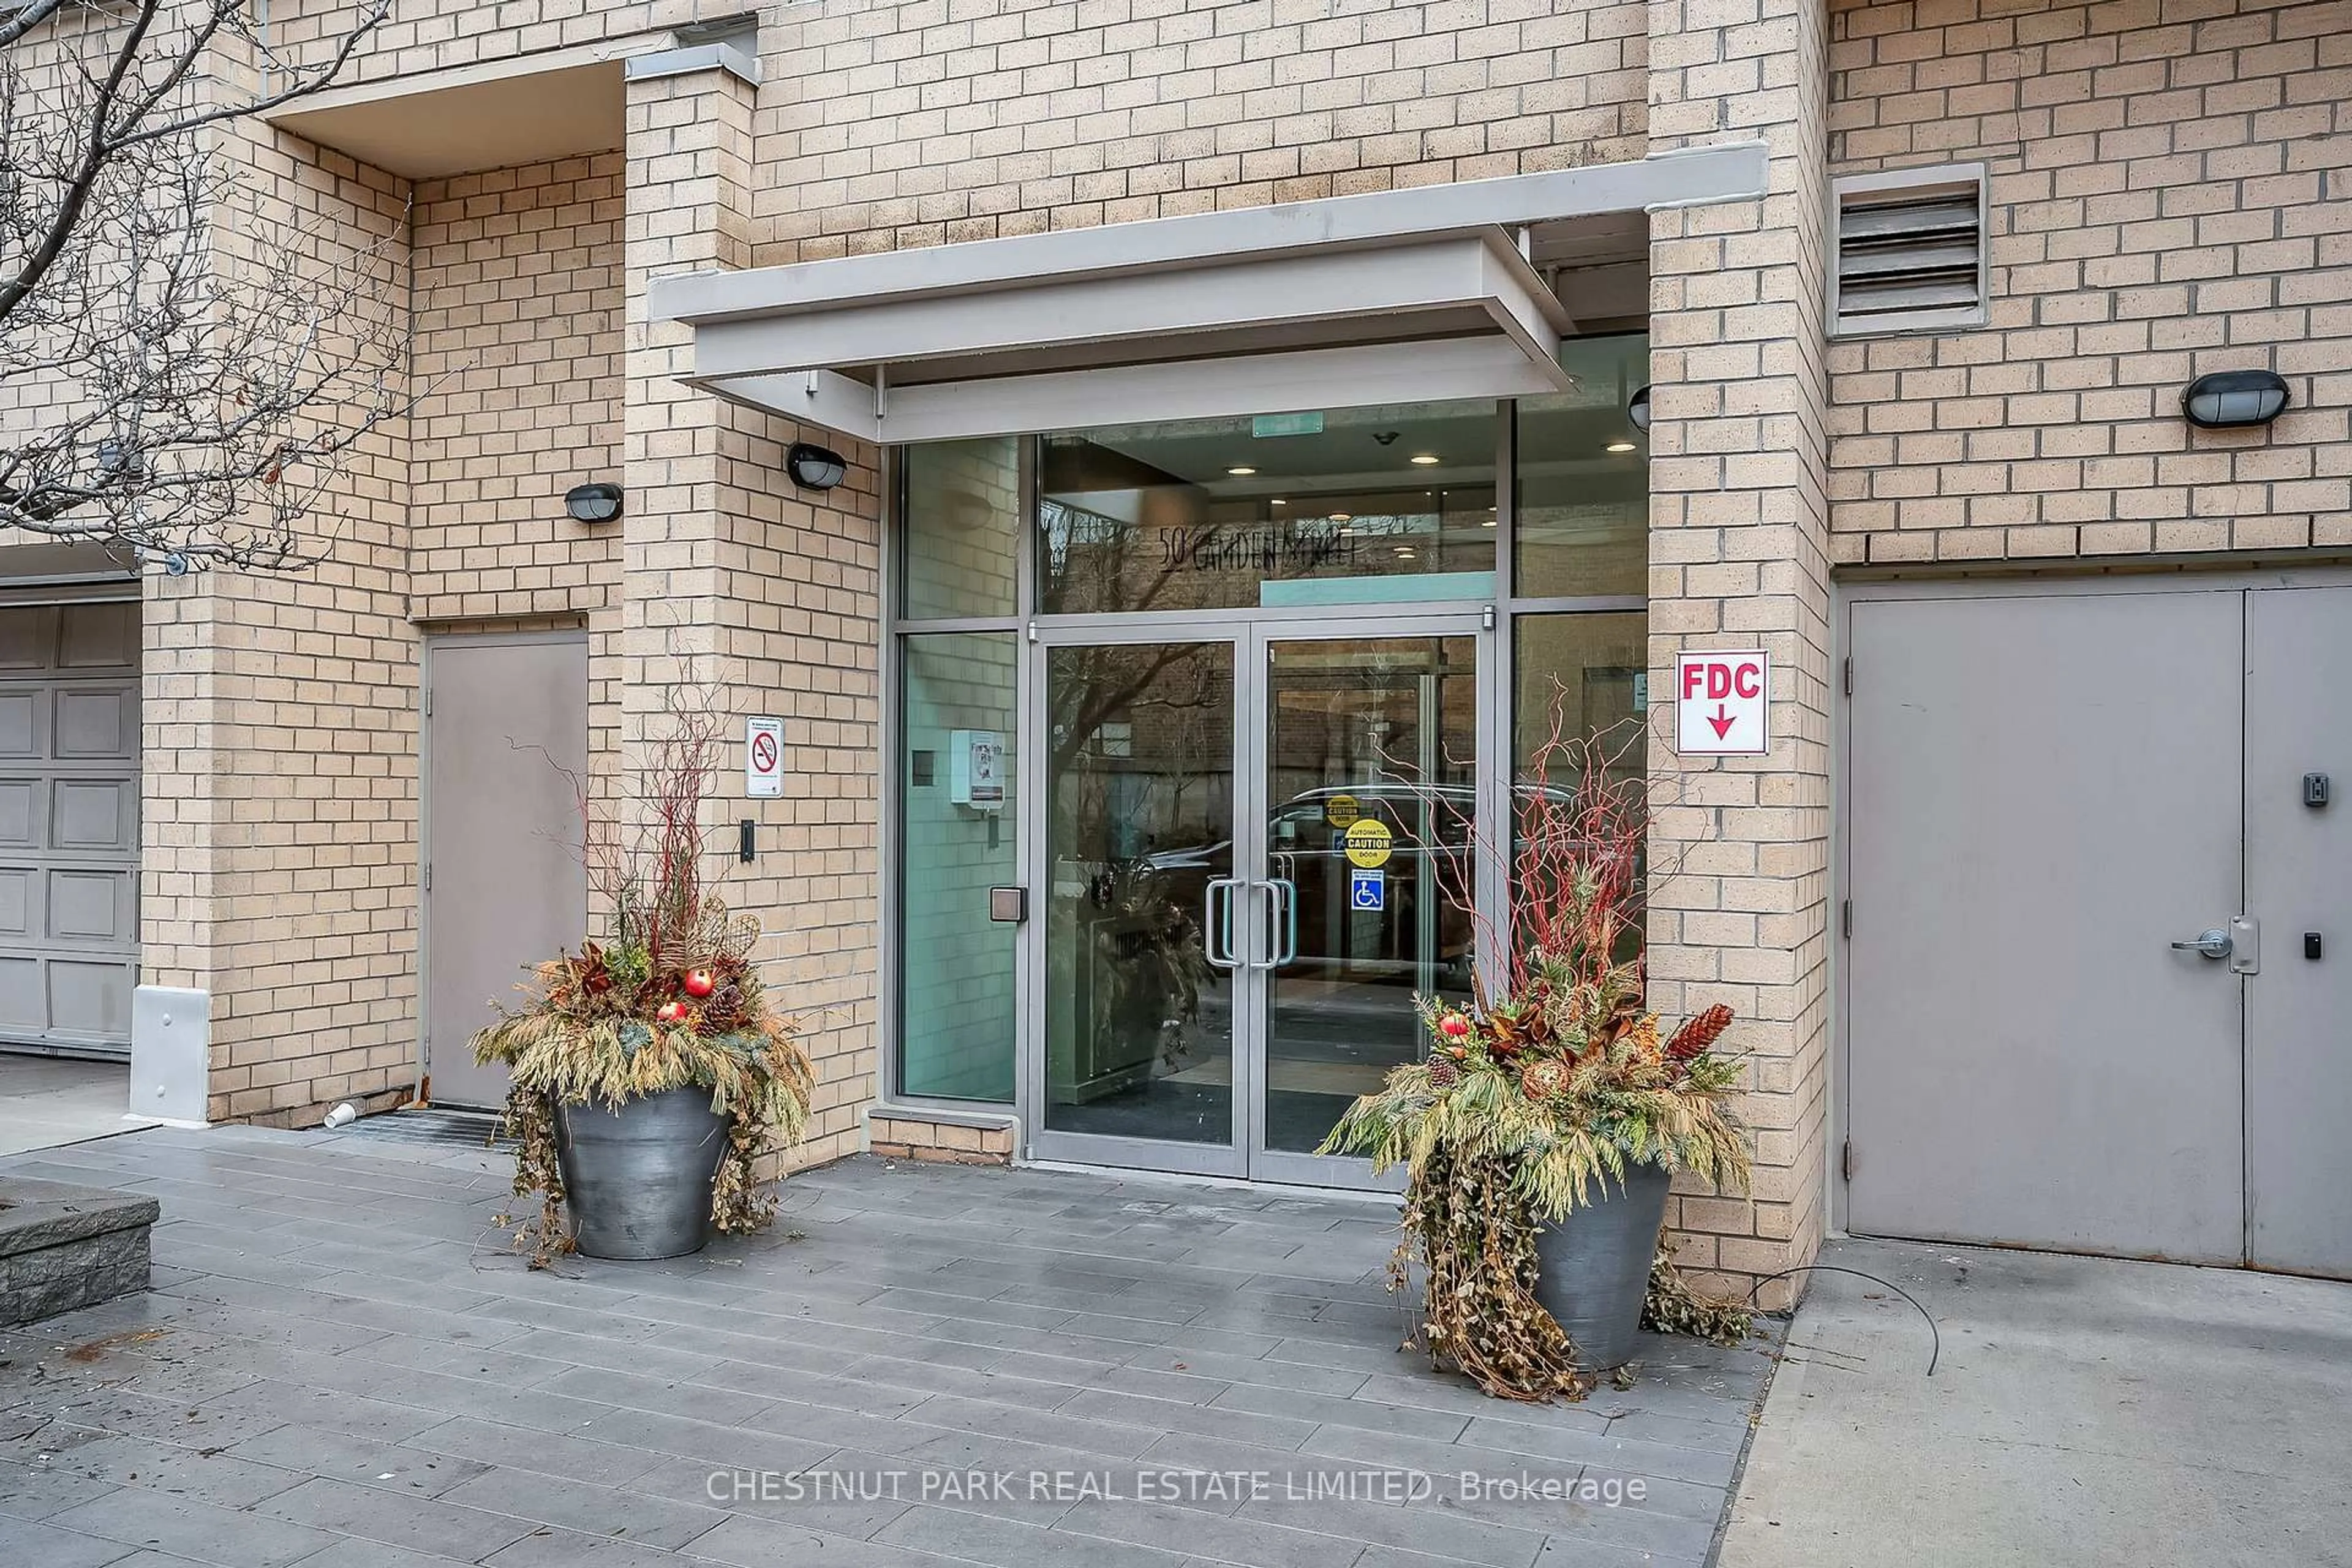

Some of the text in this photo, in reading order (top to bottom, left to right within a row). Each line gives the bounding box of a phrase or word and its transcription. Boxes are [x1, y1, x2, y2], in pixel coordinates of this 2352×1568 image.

[1156, 527, 1185, 566] 50
[1193, 528, 1276, 571] CAMDEN
[1683, 663, 1760, 699] FDC
[1348, 839, 1389, 849] CAUTION
